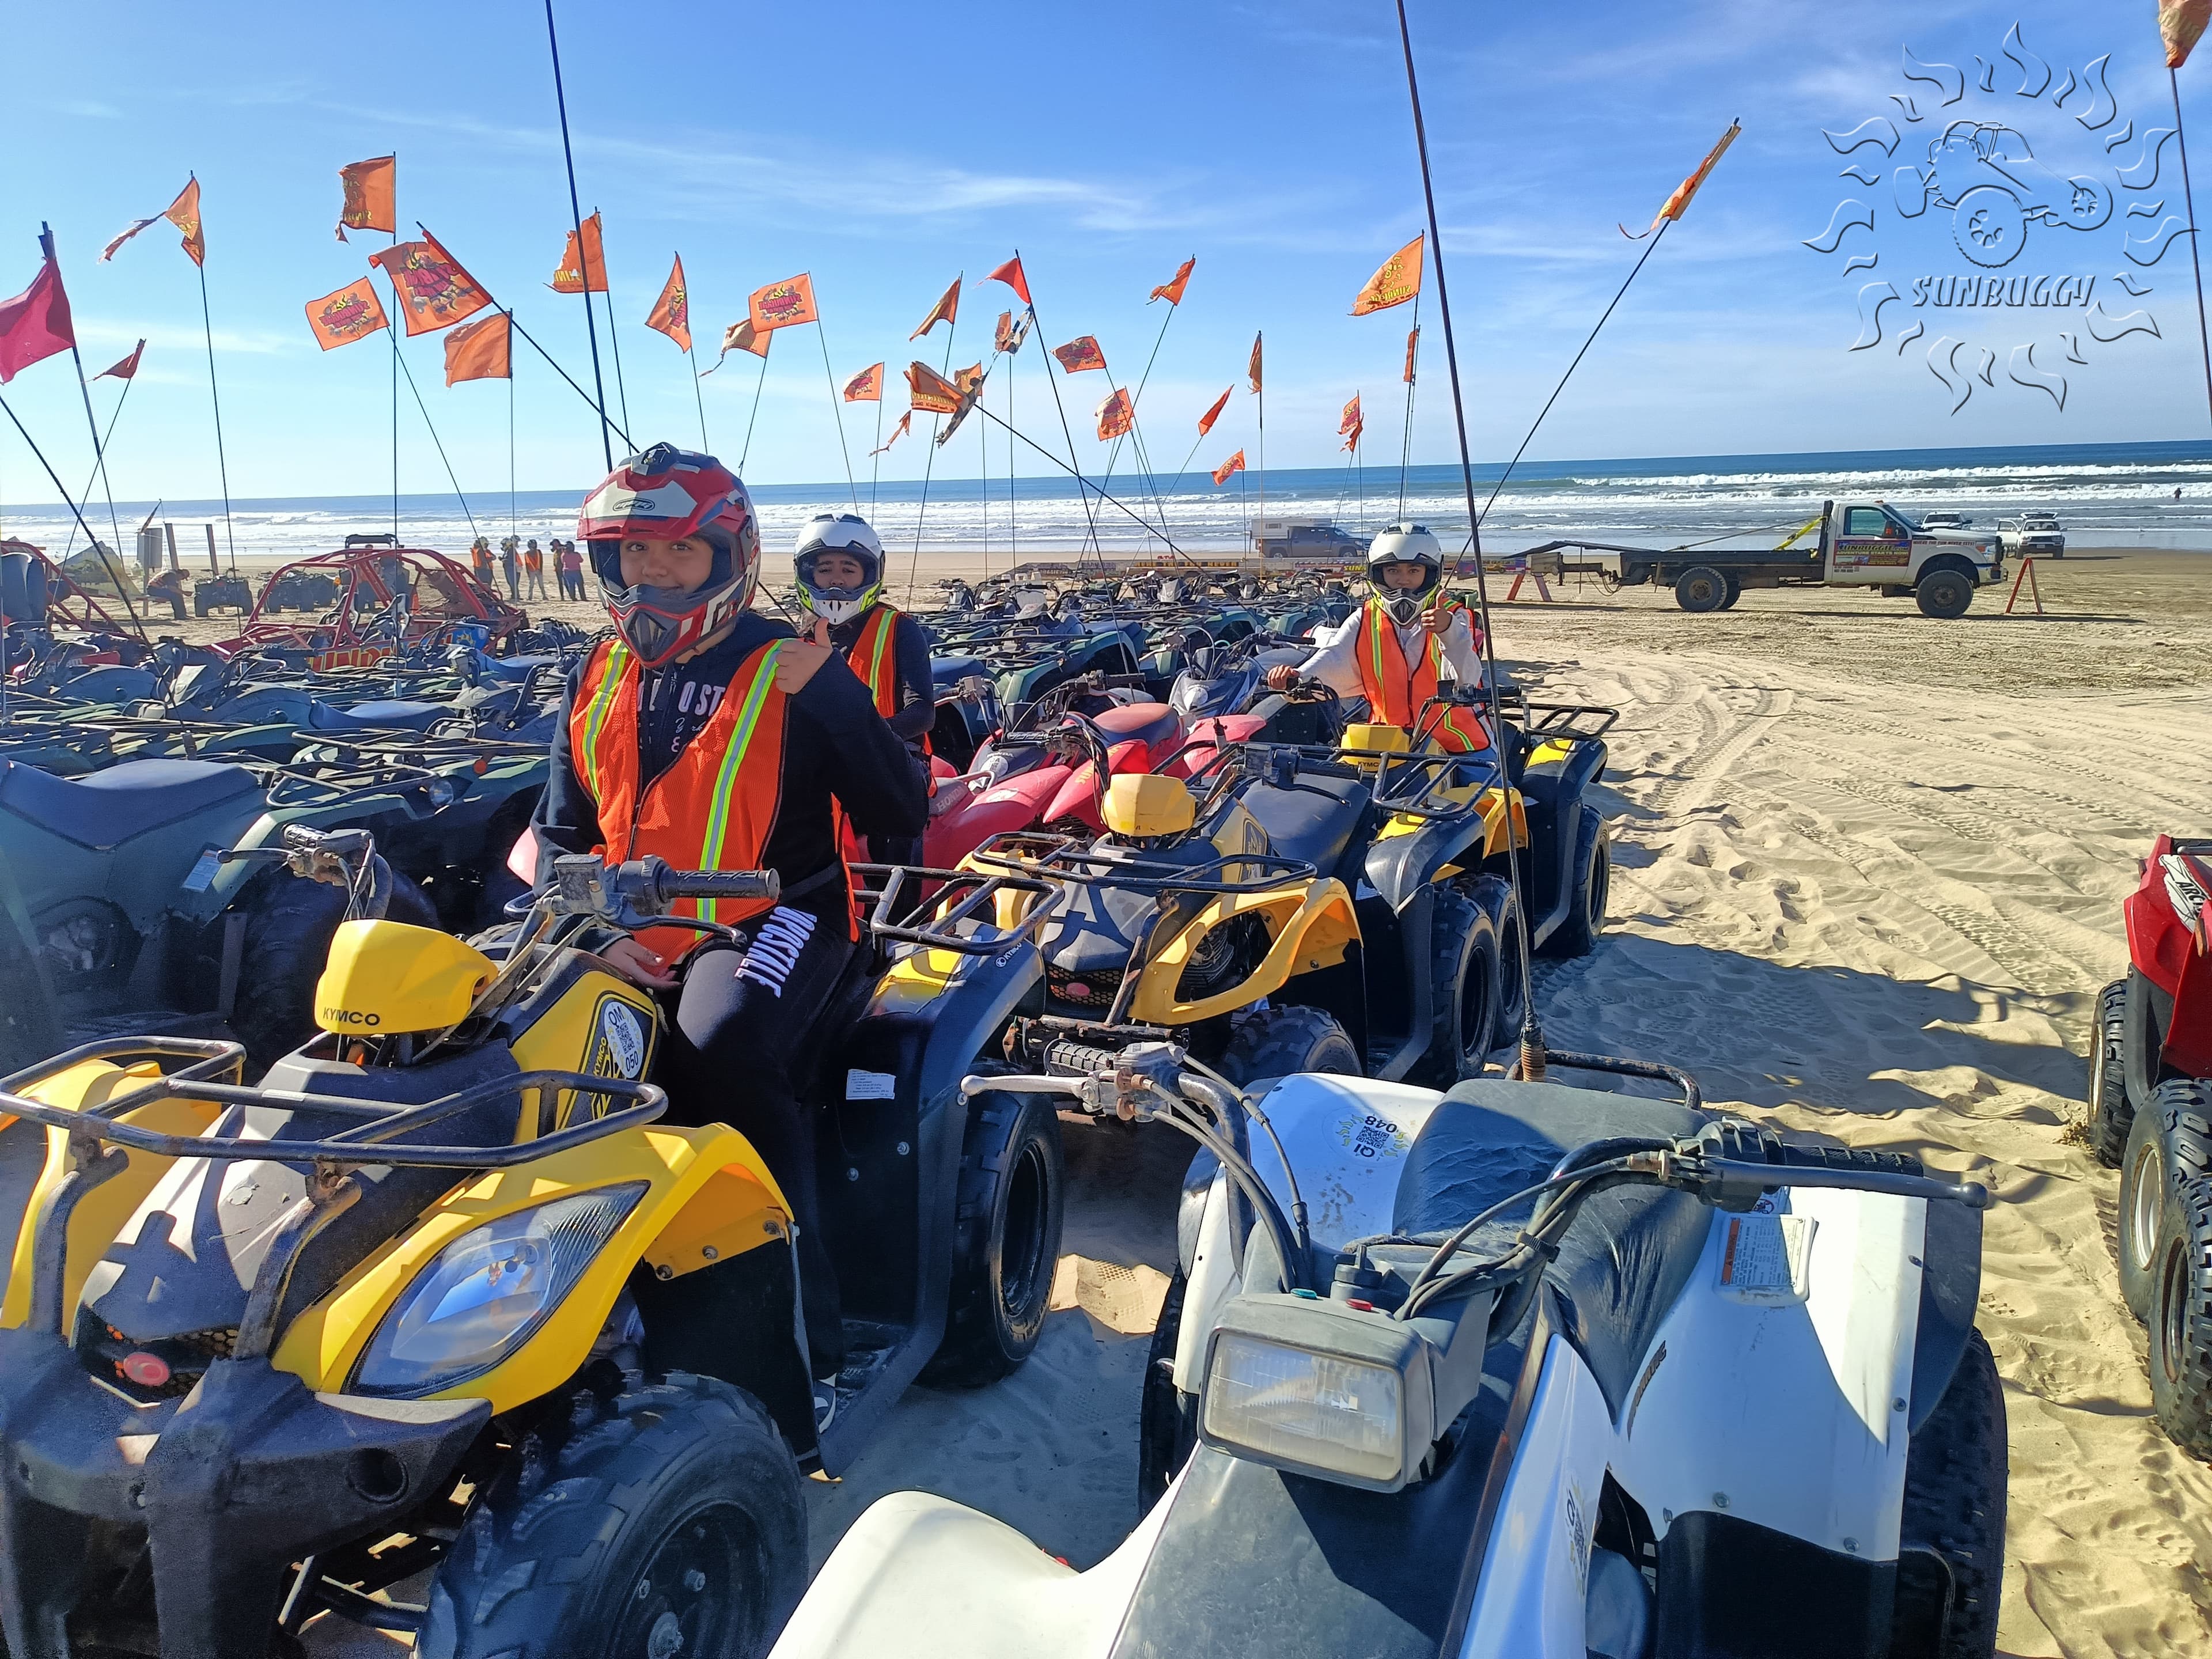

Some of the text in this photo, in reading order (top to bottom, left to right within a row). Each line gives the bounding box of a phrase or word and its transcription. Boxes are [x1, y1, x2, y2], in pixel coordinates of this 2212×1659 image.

[734, 906, 817, 998] OPOSTALE
[323, 1006, 380, 1026] KYMCO
[608, 1006, 624, 1028] QM
[593, 1036, 607, 1076] KYMCO
[626, 1051, 639, 1072] 050
[1365, 1116, 1397, 1132] 048
[1354, 1143, 1375, 1157] QI
